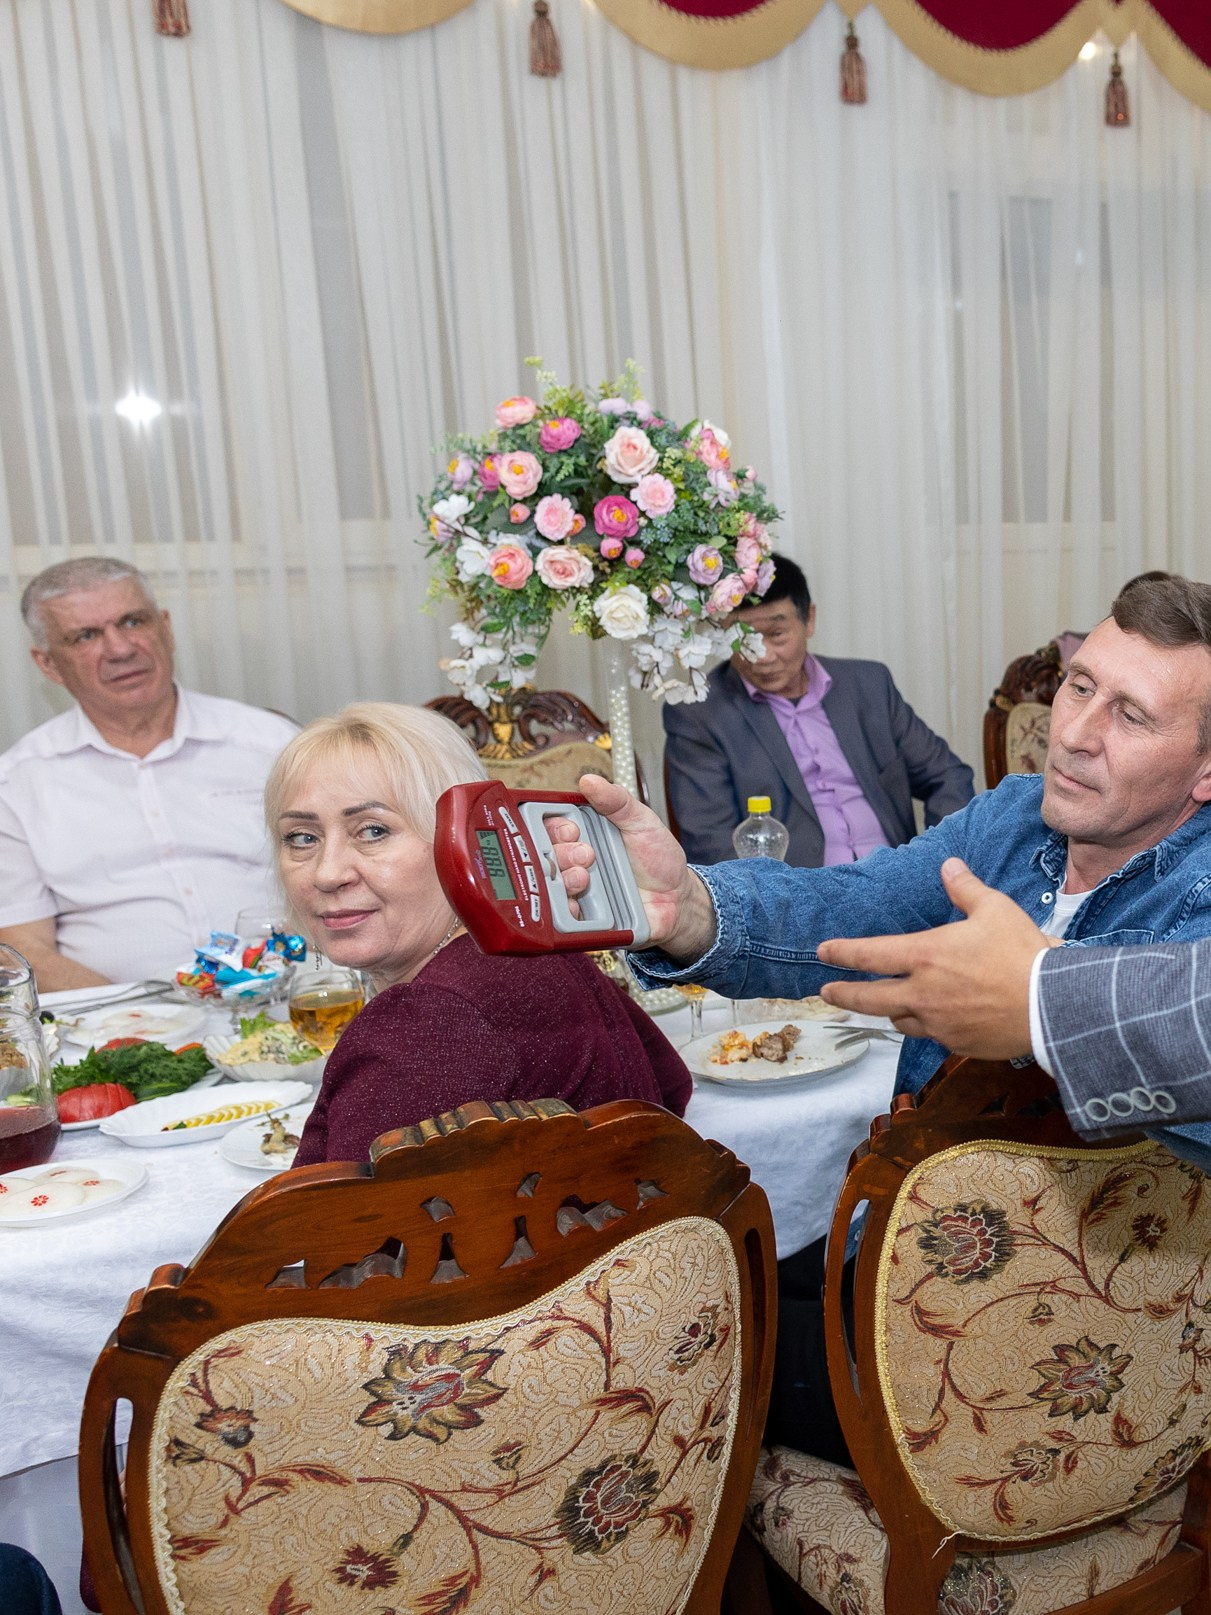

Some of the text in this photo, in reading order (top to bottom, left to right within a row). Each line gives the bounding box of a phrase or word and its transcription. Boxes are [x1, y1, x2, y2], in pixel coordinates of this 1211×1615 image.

[505, 813, 514, 827] START
[504, 828, 517, 861] DYNAMOMETER
[517, 874, 529, 901] ELECTRONIC
